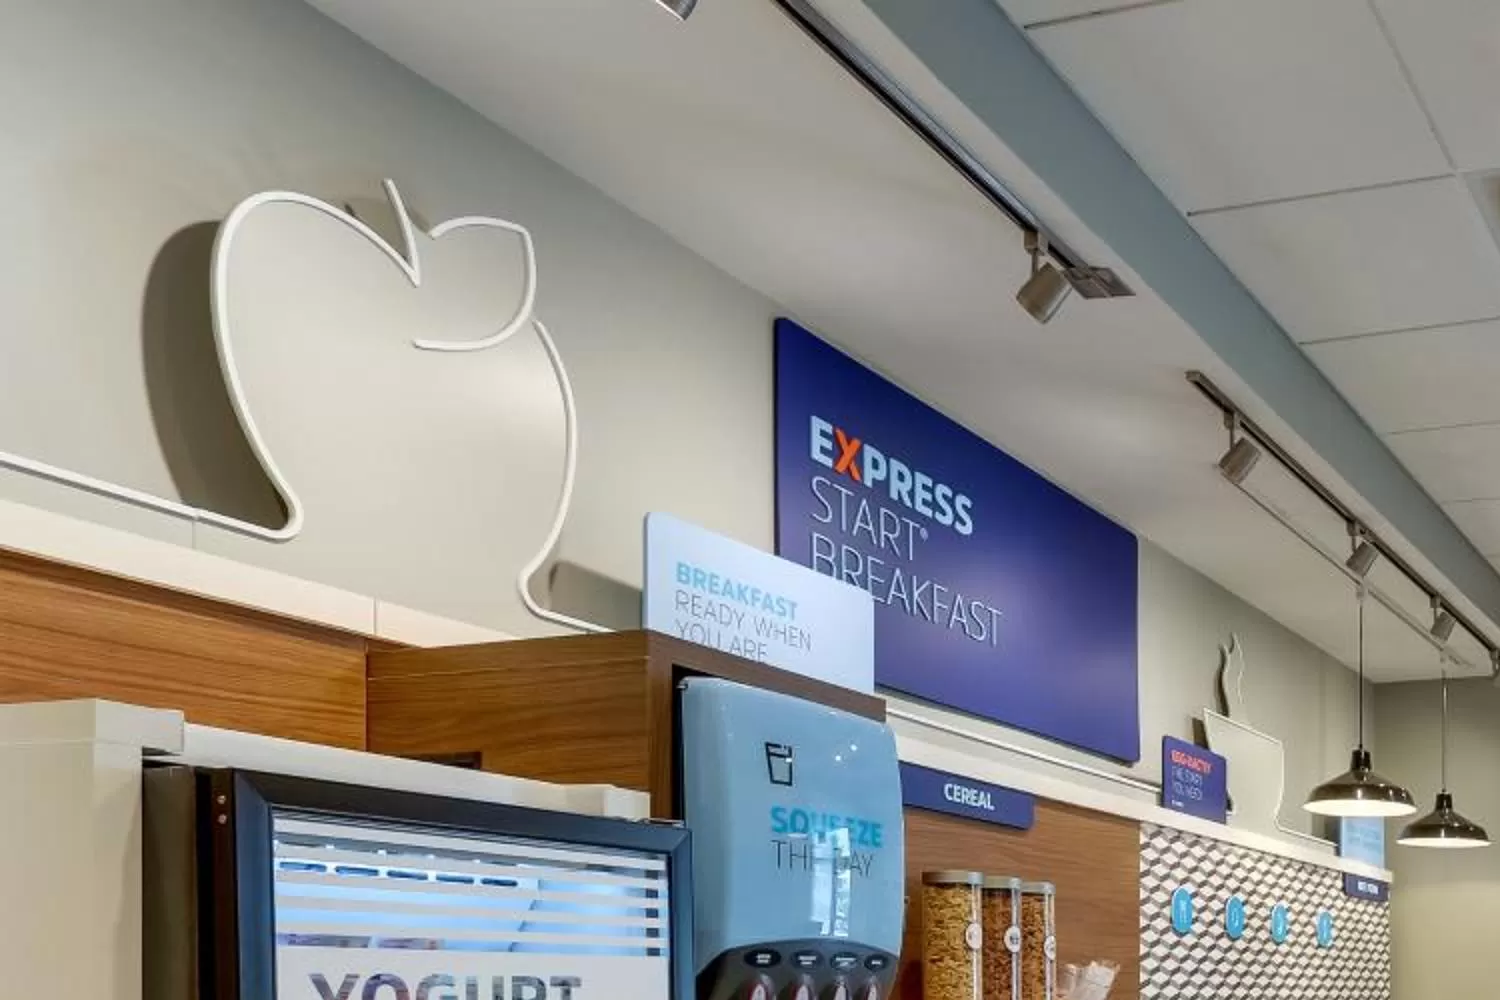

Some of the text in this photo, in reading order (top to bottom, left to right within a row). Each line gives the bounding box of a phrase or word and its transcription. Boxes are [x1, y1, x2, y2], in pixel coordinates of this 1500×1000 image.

[811, 415, 974, 536] EXPRESS
[675, 589, 813, 652] READY WHEN
[676, 562, 799, 621] BREAKFAST
[811, 532, 1003, 648] BREAKFAST
[675, 619, 722, 648] YOU
[944, 783, 996, 811] CEREAL
